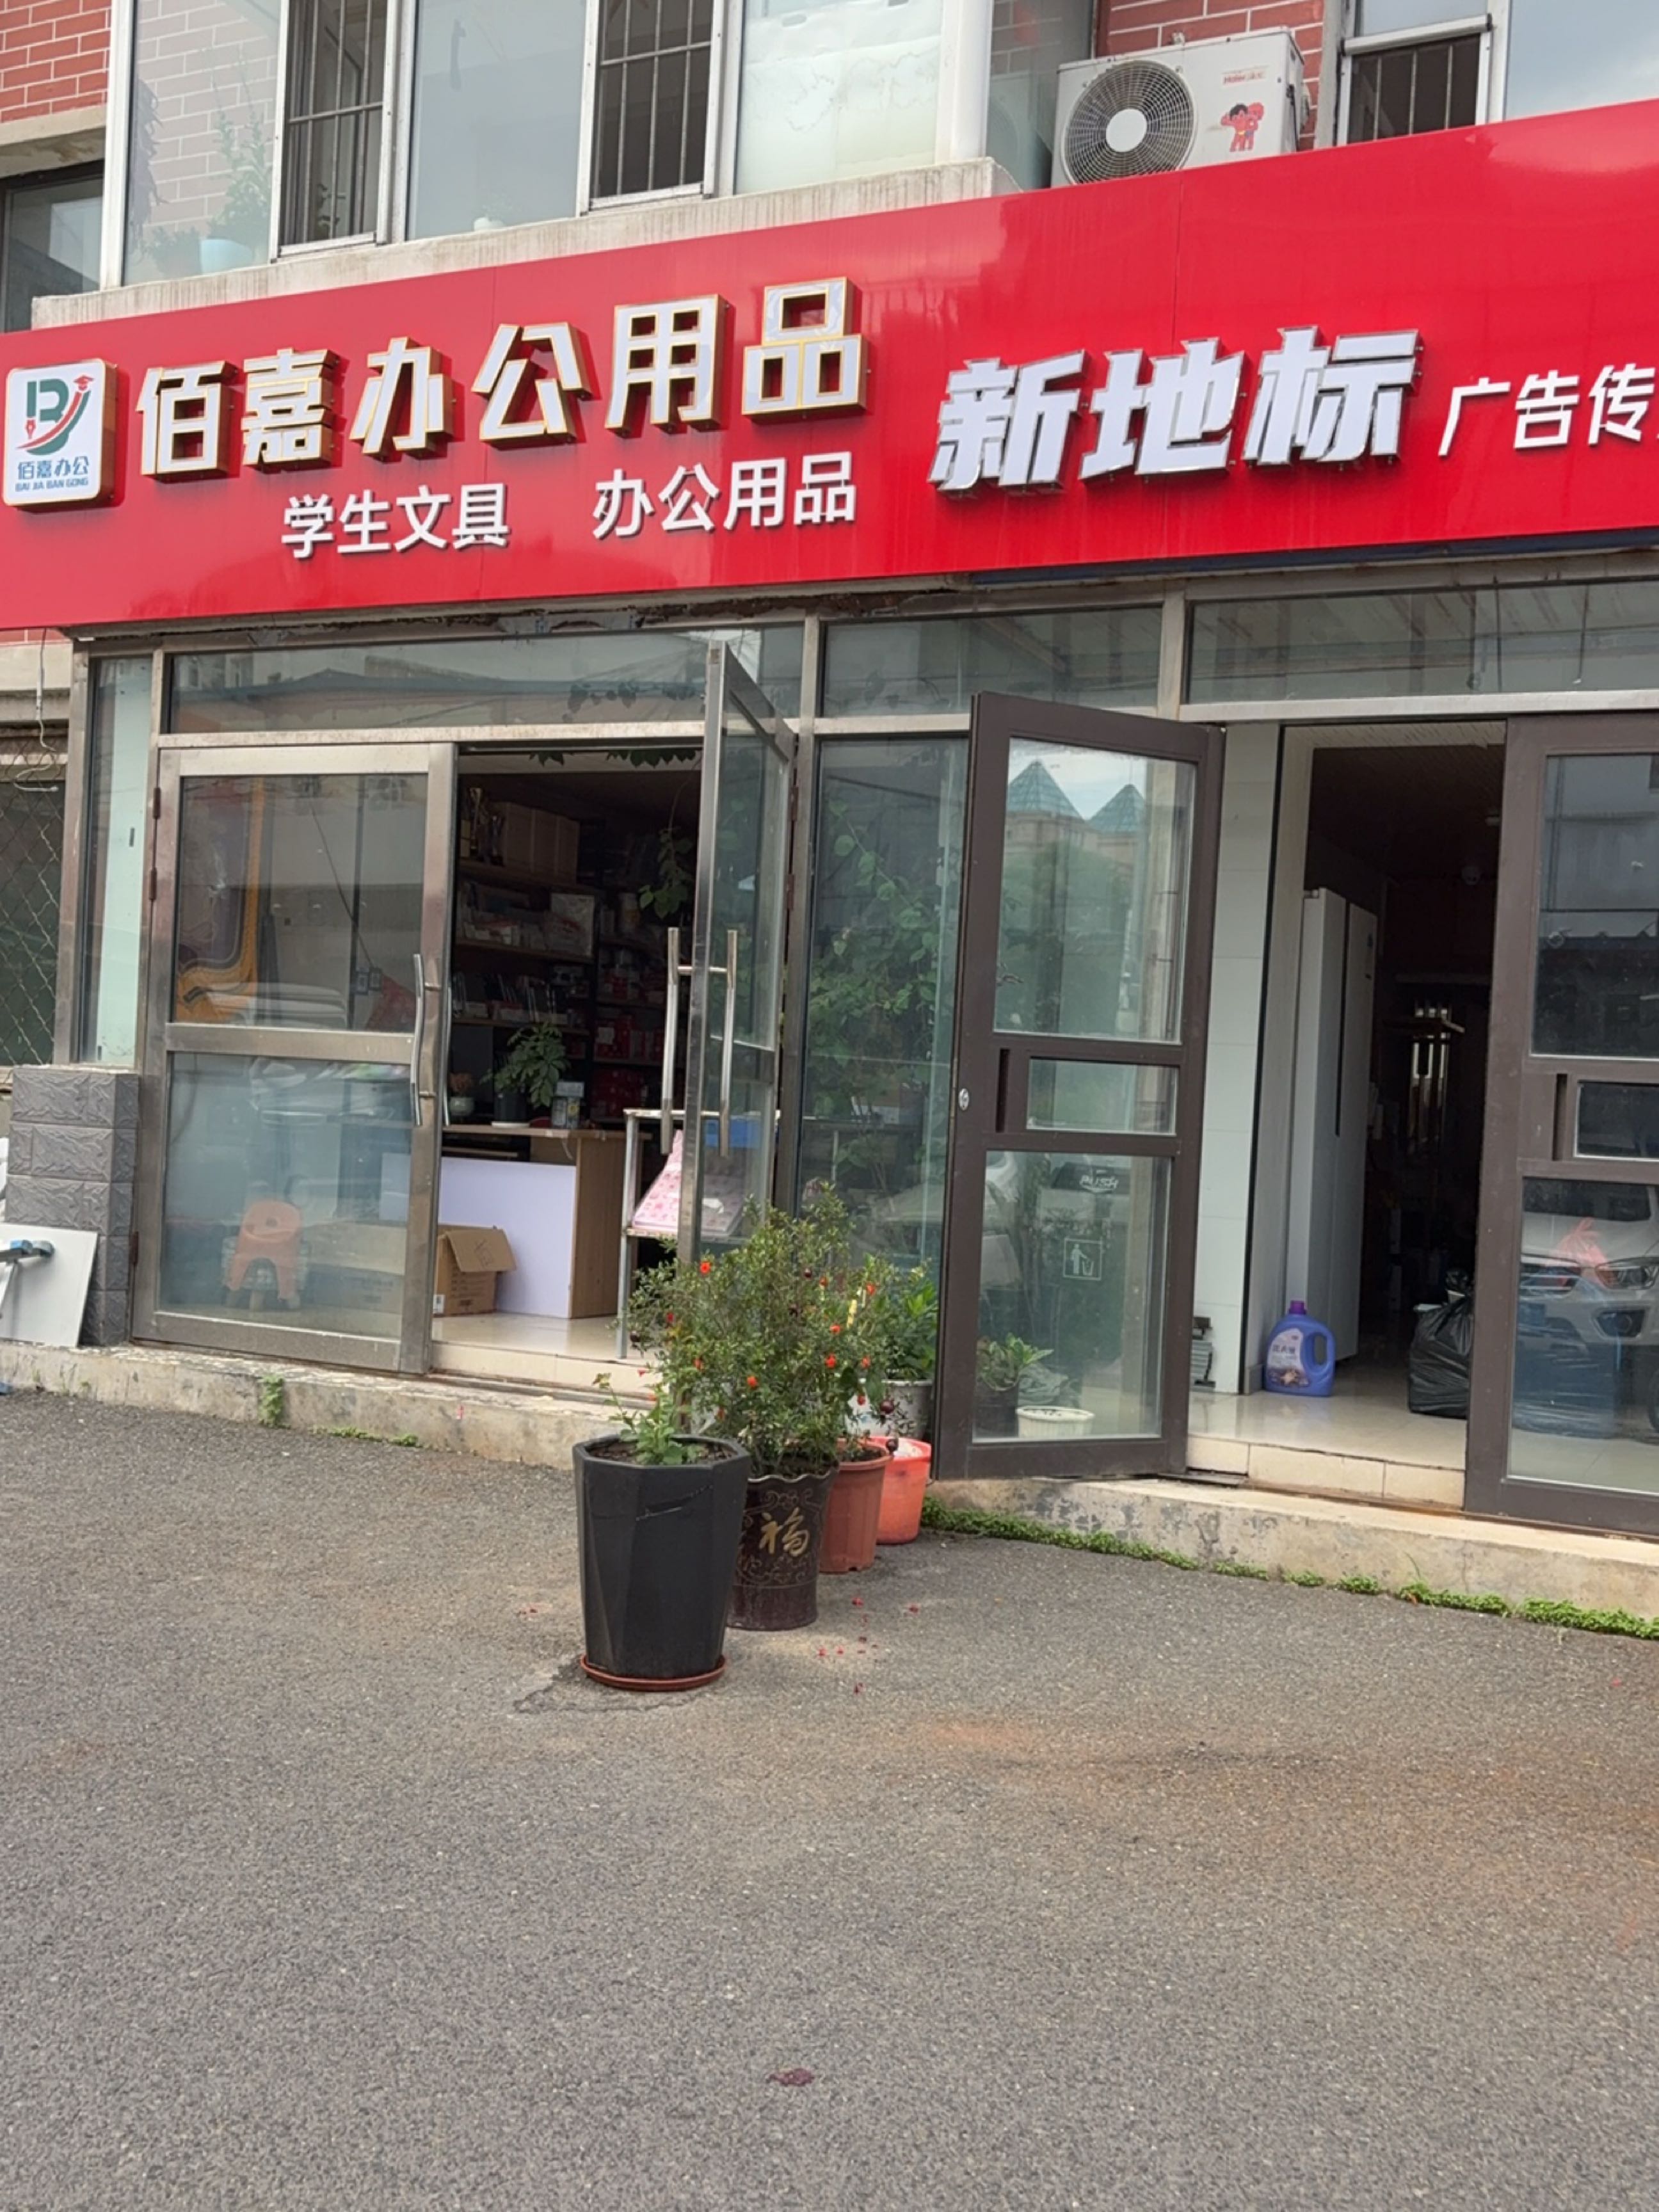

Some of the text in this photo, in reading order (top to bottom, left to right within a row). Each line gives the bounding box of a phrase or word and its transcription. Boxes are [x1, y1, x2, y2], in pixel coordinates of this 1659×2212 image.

[136, 276, 867, 480] 佰嘉办公用品
[927, 325, 1659, 494] 新地标 广告传
[281, 451, 856, 559] 学生文具 办公用品
